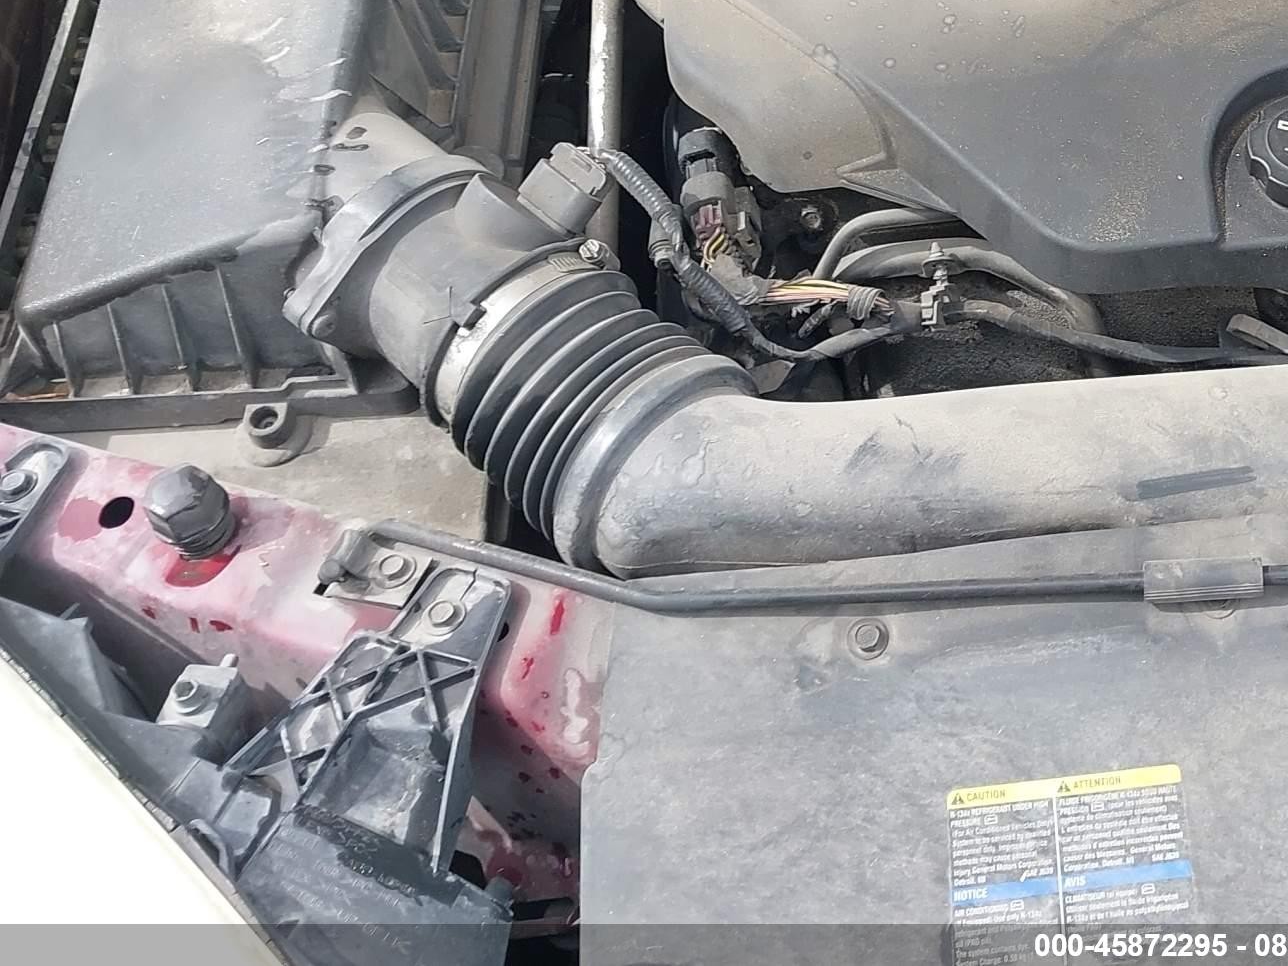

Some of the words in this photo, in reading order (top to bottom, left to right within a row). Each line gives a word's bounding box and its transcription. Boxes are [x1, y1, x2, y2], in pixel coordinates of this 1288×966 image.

[1074, 776, 1121, 789] ATTENTION
[966, 790, 1006, 801] CAUTION
[1064, 876, 1086, 888] AVIS
[954, 888, 988, 901] NOTICE
